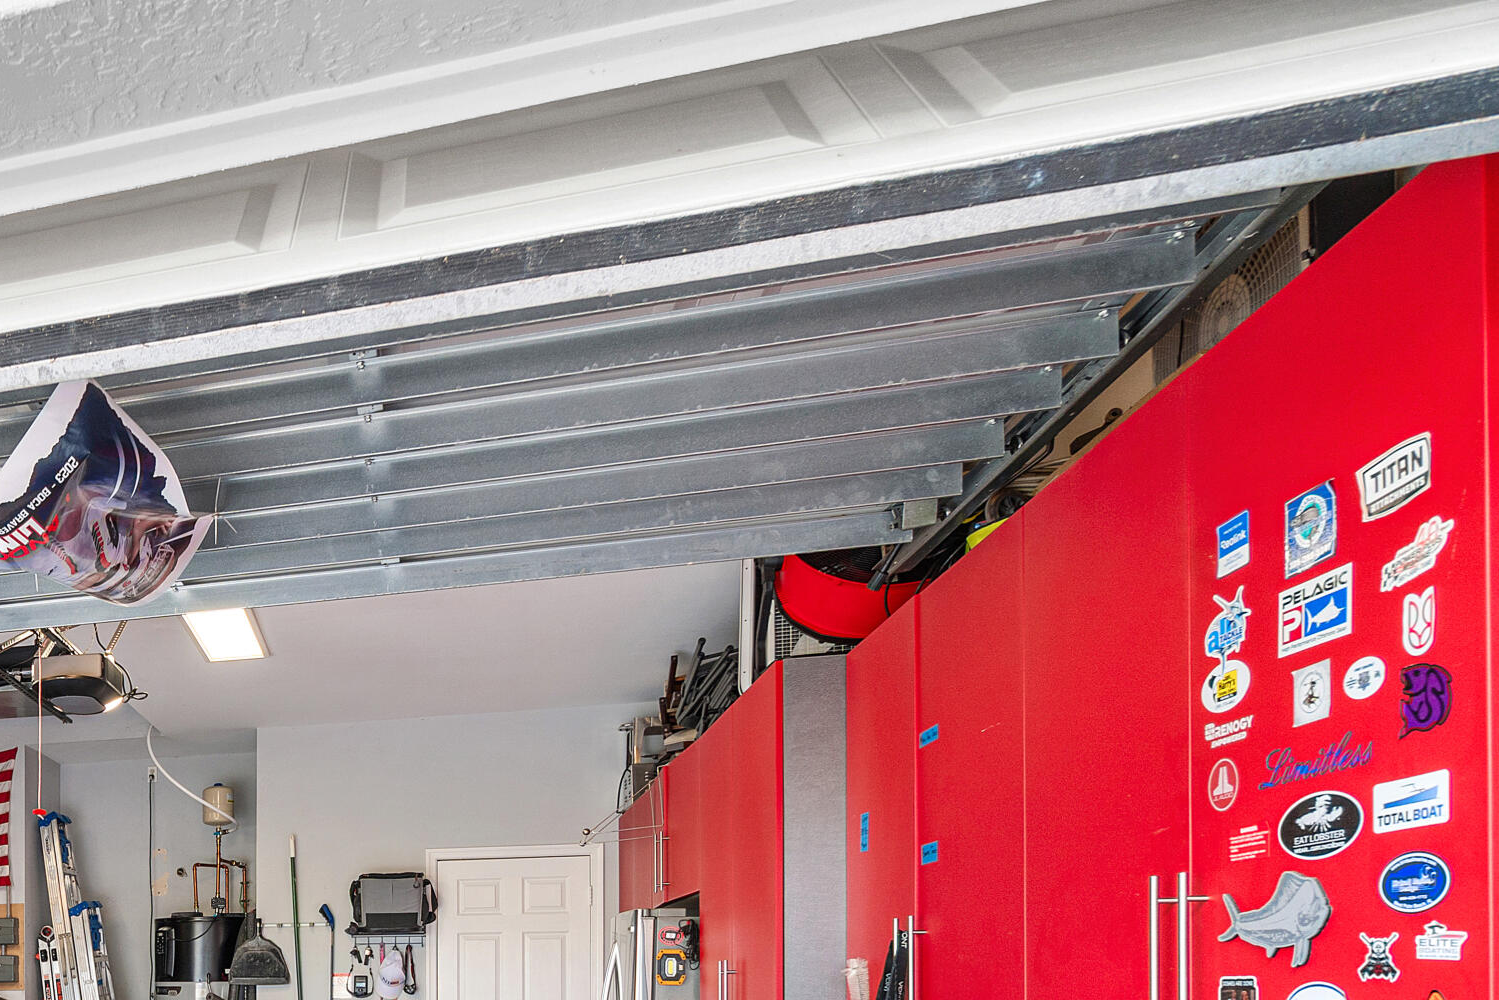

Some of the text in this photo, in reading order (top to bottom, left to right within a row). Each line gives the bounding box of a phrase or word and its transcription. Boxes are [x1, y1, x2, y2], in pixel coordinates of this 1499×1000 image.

[55, 456, 79, 484] 2023
[1370, 446, 1423, 493] TITAN
[27, 487, 51, 511] BOCA
[1282, 570, 1348, 610] PELAGIC
[1214, 715, 1254, 736] RENOGY
[1258, 731, 1373, 790] Limitless
[1294, 829, 1345, 846] EAT LOBSTER
[901, 932, 909, 949] ONT
[1419, 938, 1459, 948] ELITE
